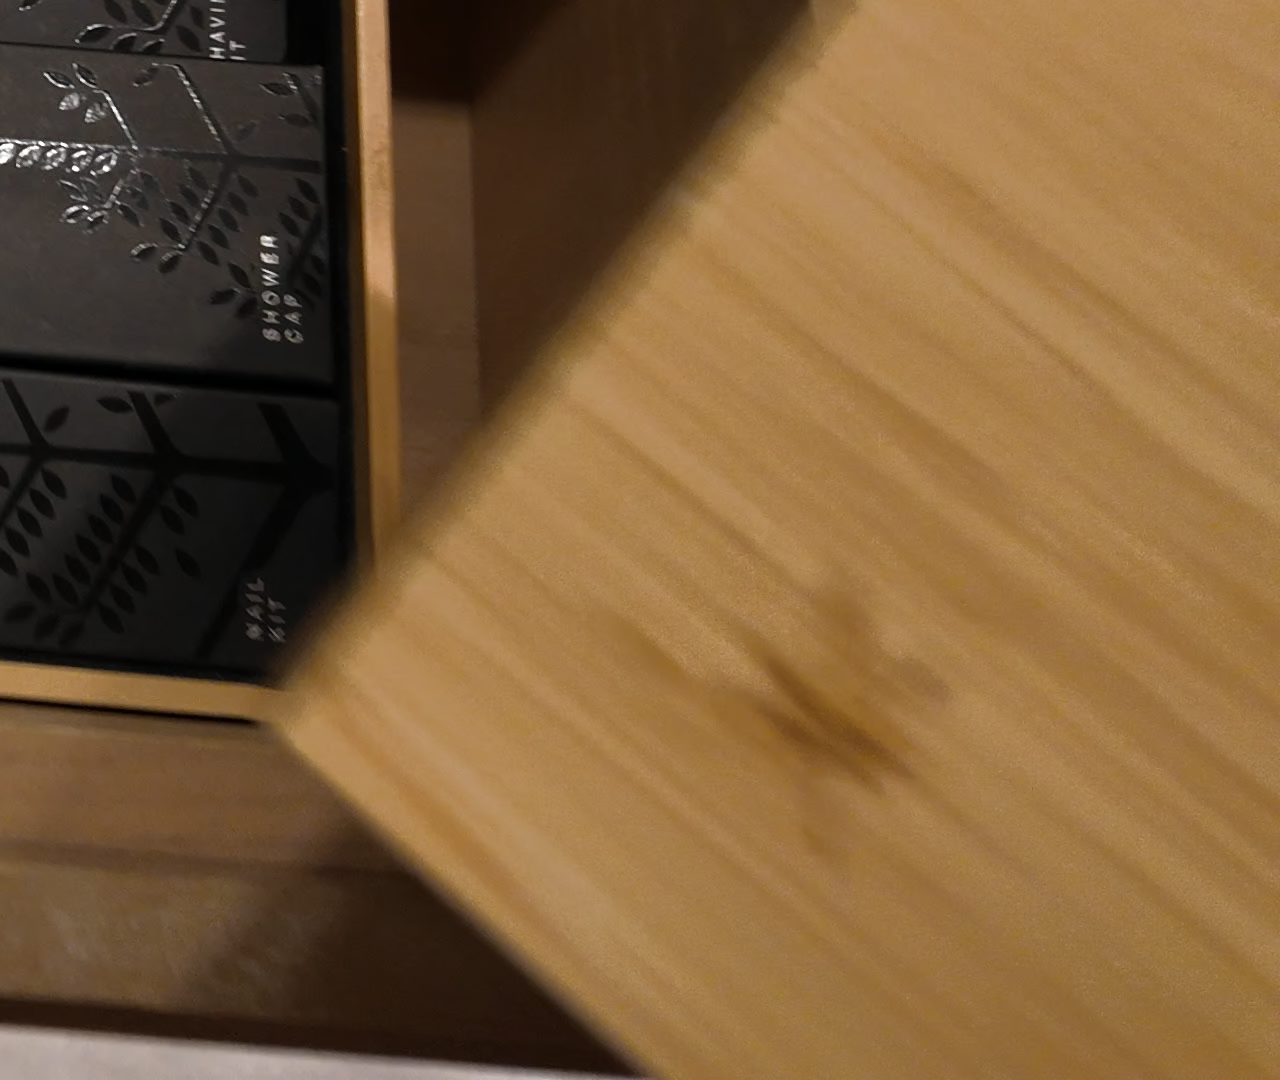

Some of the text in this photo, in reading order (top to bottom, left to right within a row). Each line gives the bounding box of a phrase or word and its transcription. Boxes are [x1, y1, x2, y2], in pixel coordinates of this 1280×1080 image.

[229, 40, 247, 60] IT
[260, 234, 281, 342] SHOWER
[283, 293, 304, 344] CAP
